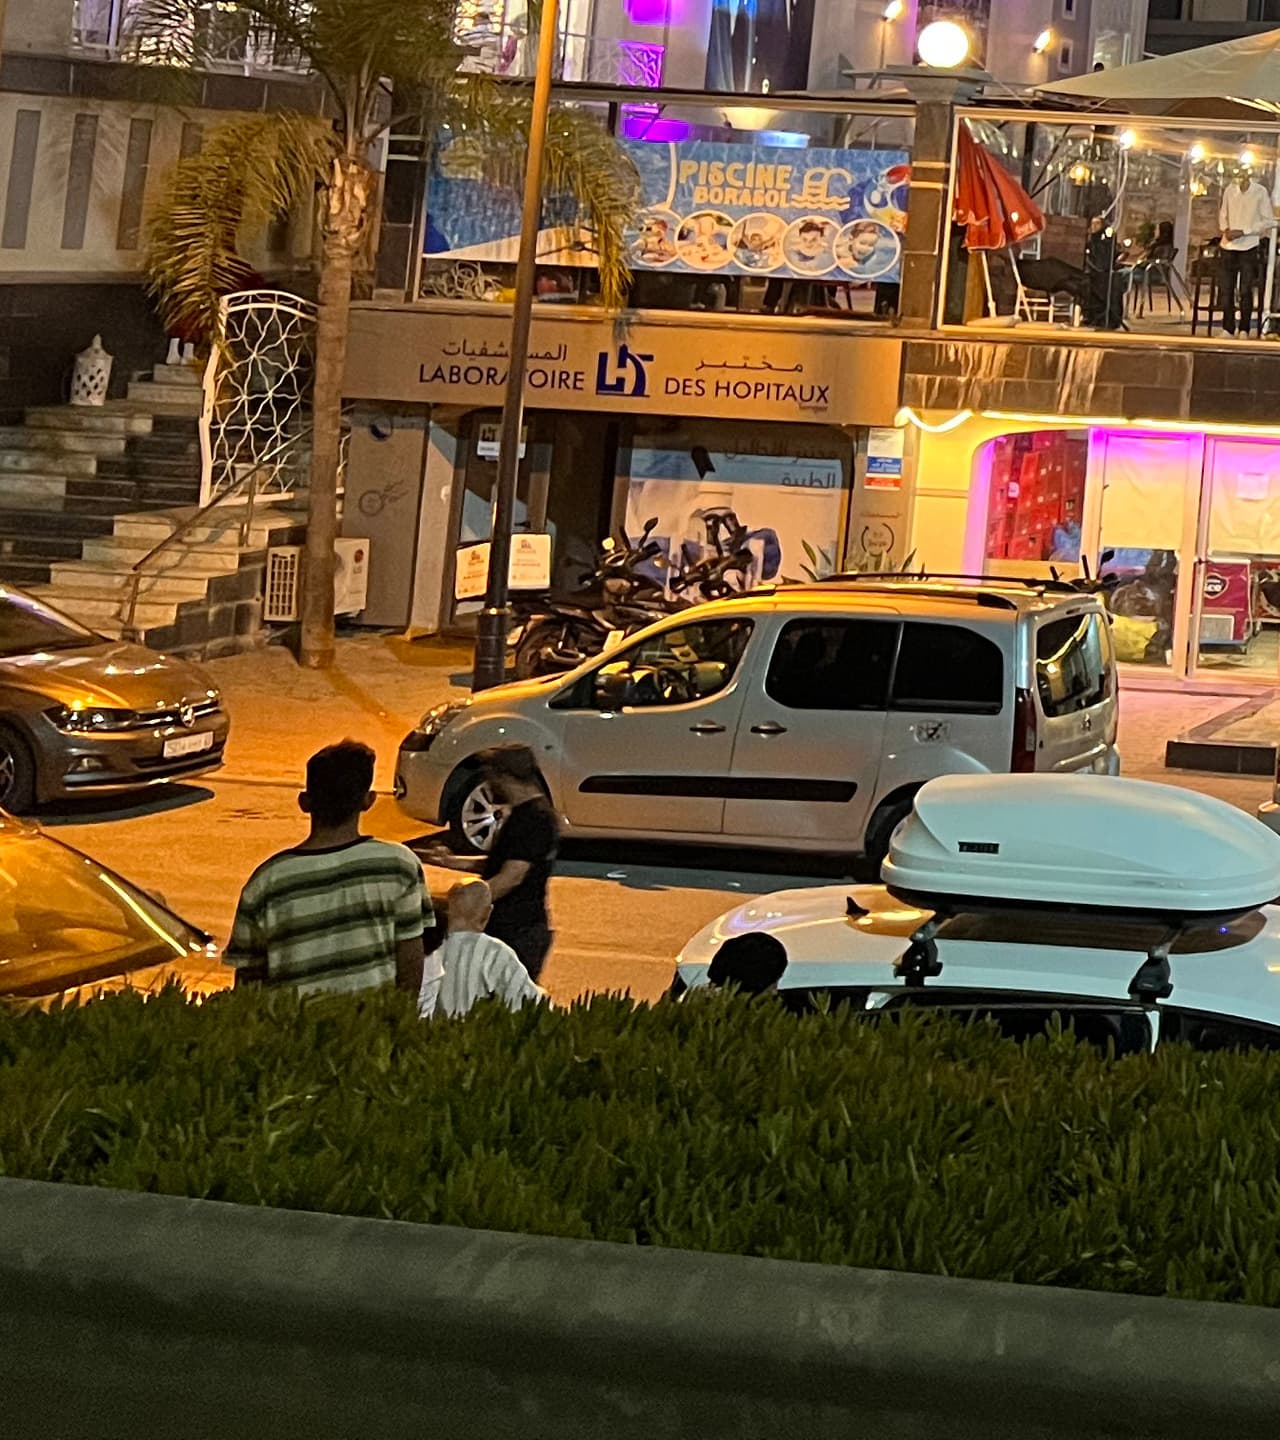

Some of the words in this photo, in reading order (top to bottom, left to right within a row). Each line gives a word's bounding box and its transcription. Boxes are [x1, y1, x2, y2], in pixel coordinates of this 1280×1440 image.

[678, 160, 792, 190] PISCINE
[693, 185, 792, 208] BORASOL
[442, 339, 568, 361] المسشفيات
[695, 354, 804, 374] مختبر
[419, 364, 586, 391] LABOROIRE
[664, 377, 706, 397] DES
[714, 380, 830, 404] HOPITAUX
